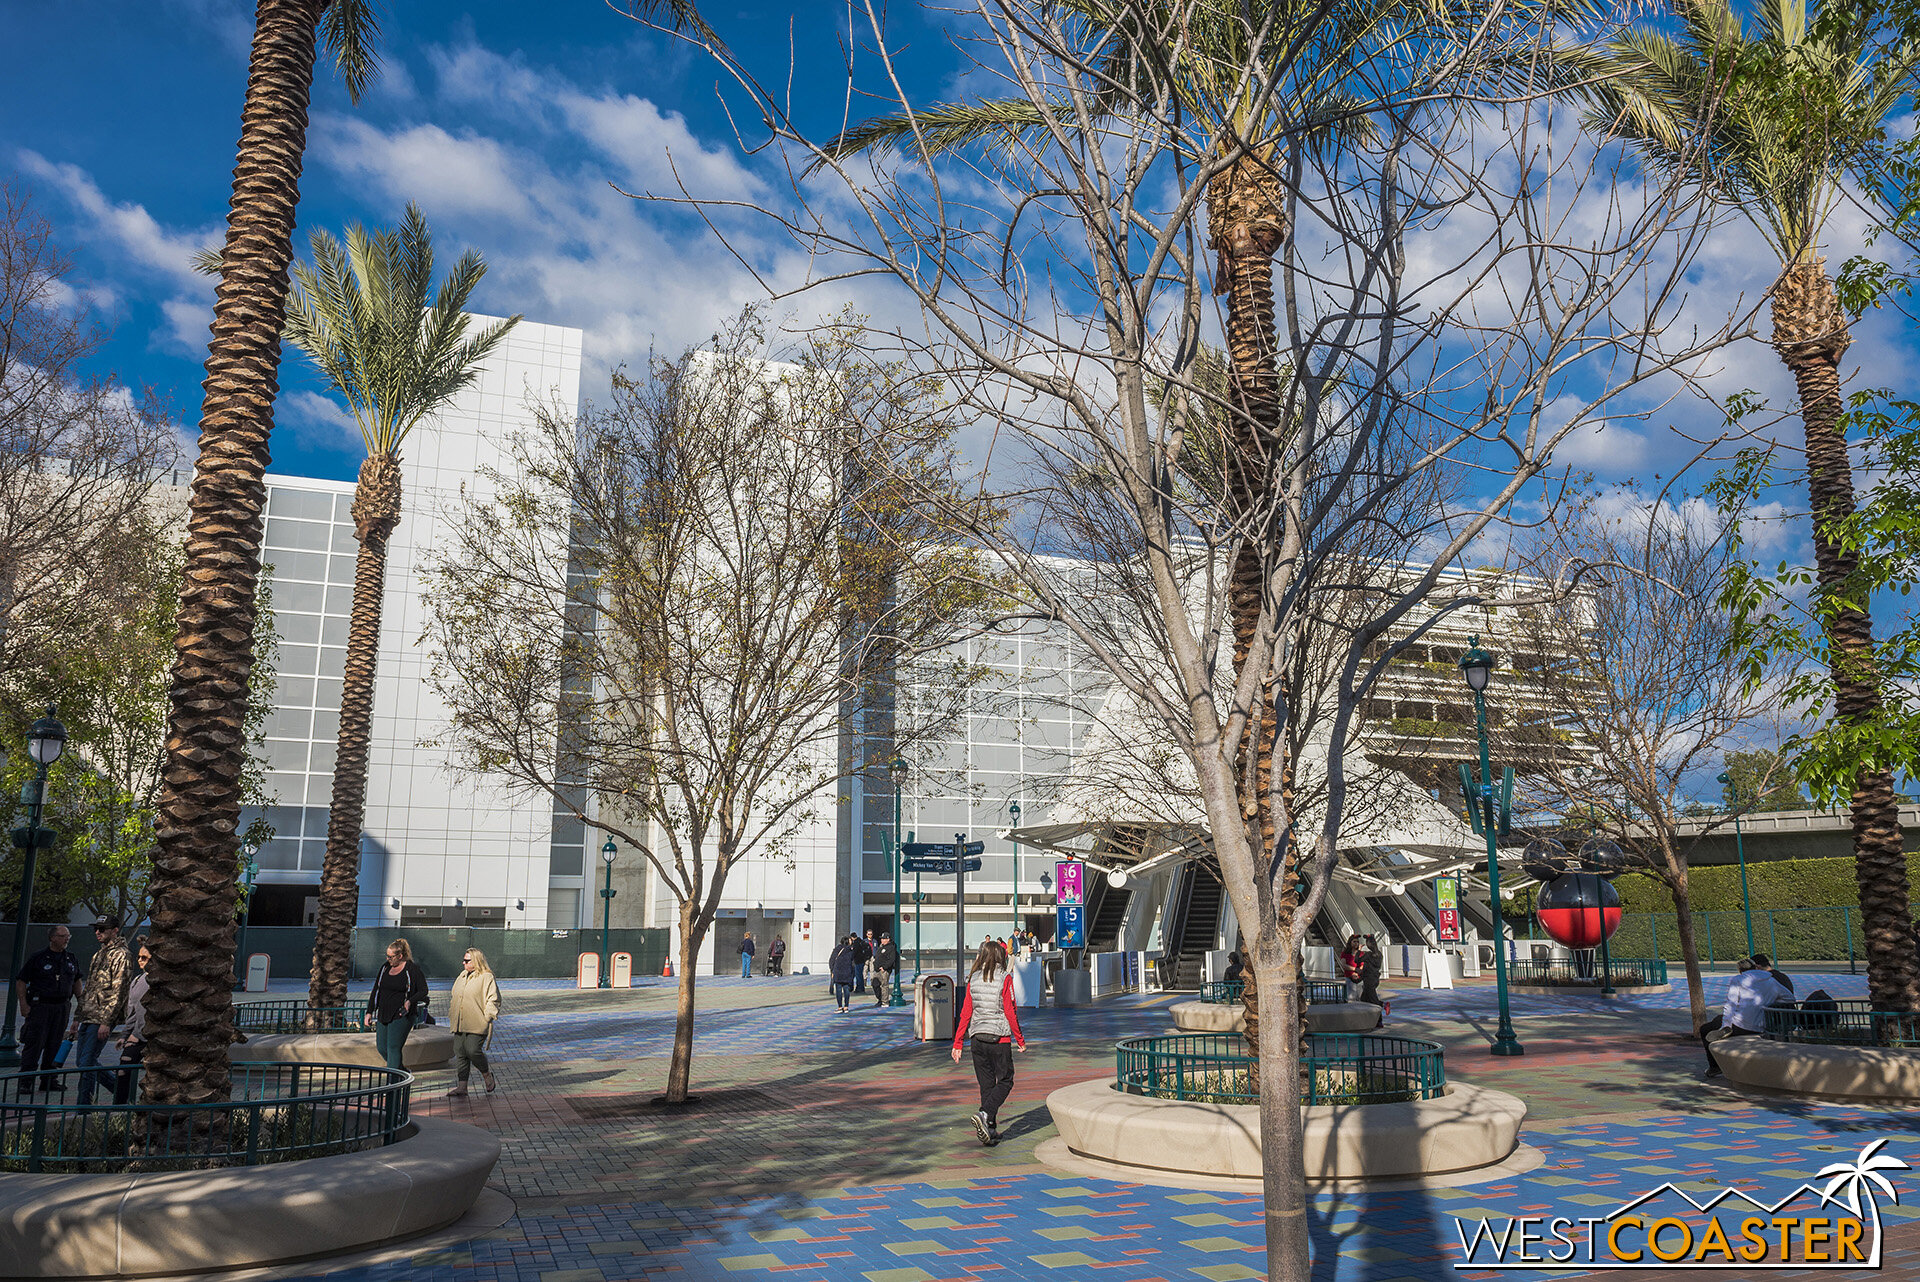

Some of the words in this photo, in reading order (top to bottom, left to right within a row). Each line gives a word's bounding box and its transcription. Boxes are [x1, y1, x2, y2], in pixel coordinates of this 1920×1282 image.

[1068, 864, 1076, 878] 6
[1445, 880, 1451, 890] 4
[1069, 908, 1077, 921] 5
[1447, 910, 1453, 920] 3
